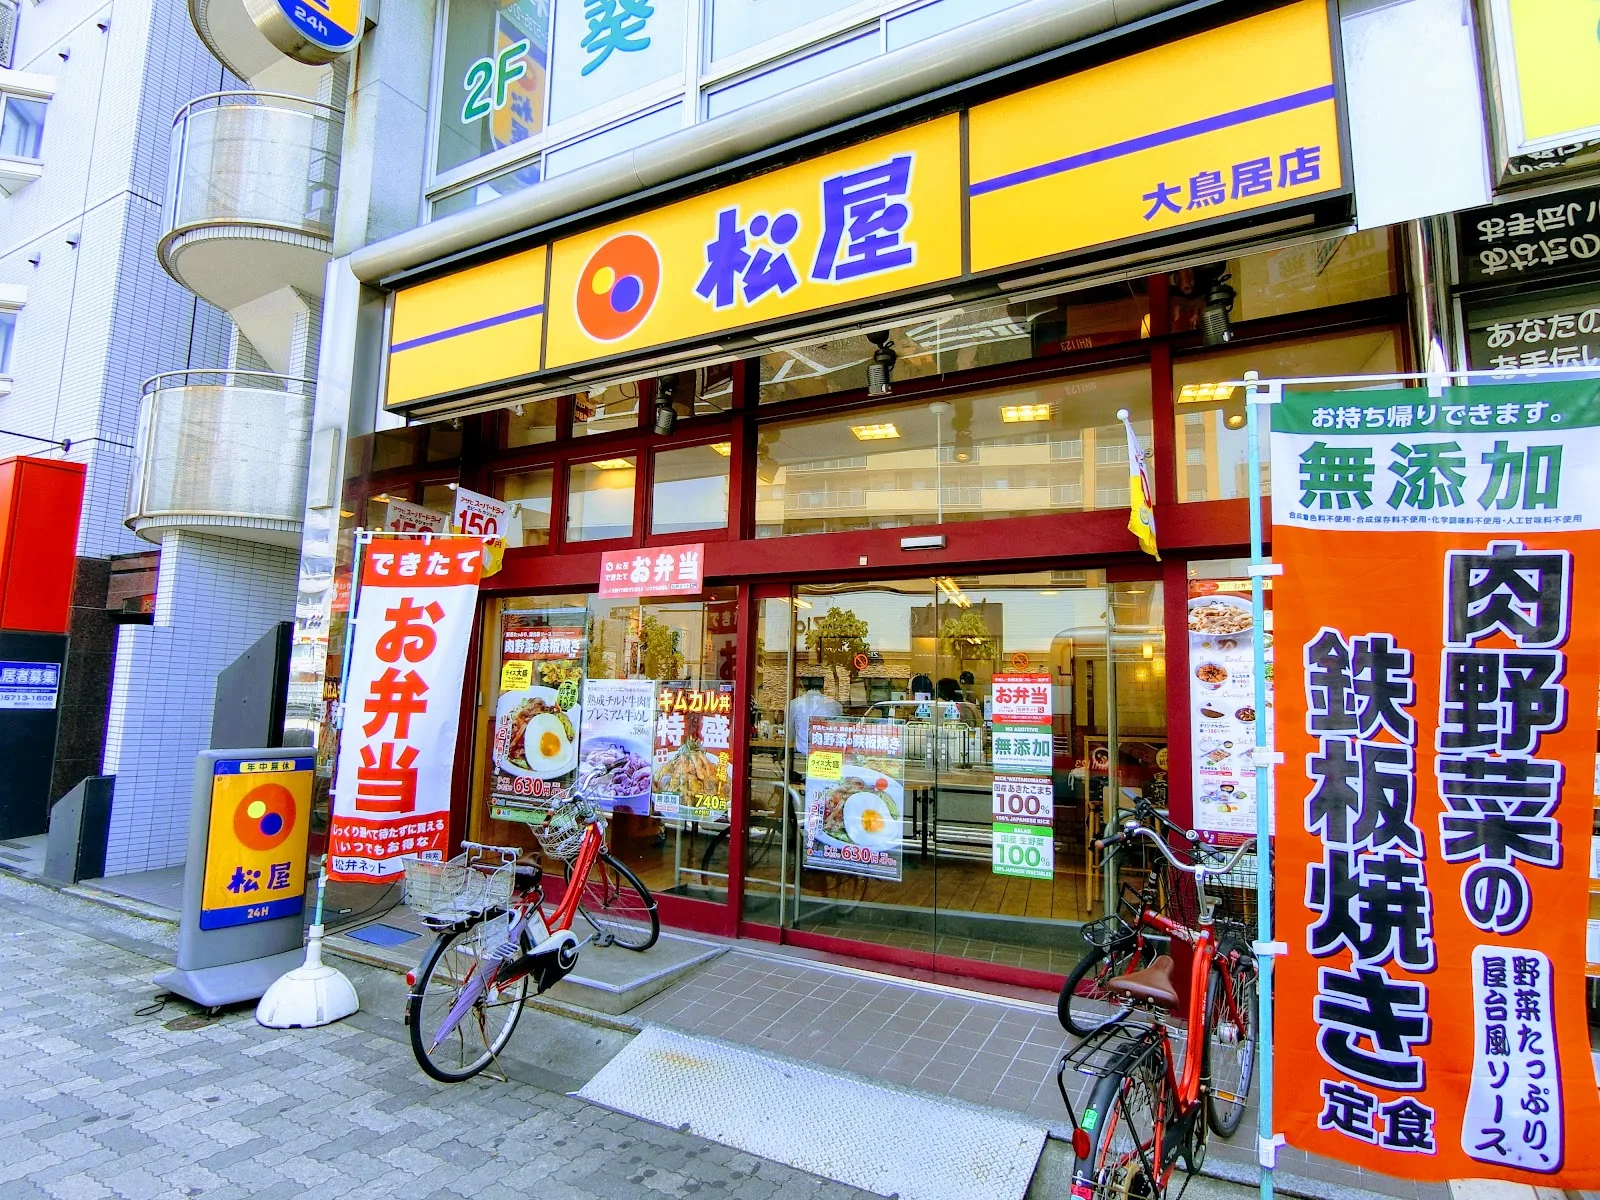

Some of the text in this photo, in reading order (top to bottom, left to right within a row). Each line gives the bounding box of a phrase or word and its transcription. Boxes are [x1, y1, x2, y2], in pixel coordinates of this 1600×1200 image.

[294, 5, 328, 37] 24h
[462, 39, 530, 123] 2F
[1142, 146, 1320, 221] 大鳥居店
[694, 154, 914, 309] 松屋
[1486, 309, 1600, 348] あなたの
[1312, 401, 1563, 430] お持ち帰りできます。
[1298, 441, 1564, 512] 無添加
[372, 550, 481, 577] できたて
[631, 551, 699, 583] お弁当
[605, 573, 628, 582] できたて
[504, 639, 581, 653] 肉野菜の鉄板焼き
[0, 668, 56, 685] 居者募集
[355, 597, 447, 813] お弁当
[659, 688, 731, 712] キムカル丼
[995, 686, 1048, 705] お弁当
[587, 708, 649, 723] プレミアム牛めし
[657, 712, 731, 748] 特盛
[811, 732, 901, 751] 肉野菜の鉄板焼き
[1437, 541, 1571, 933] 肉野菜の
[994, 737, 1050, 757] 無添加
[247, 761, 290, 771] 年中無休
[695, 794, 727, 810] 740円
[994, 783, 1052, 796] 国産あきたこまち
[996, 793, 1050, 815] 100%
[333, 819, 445, 840] じっくり選べて待たずに買える
[340, 836, 430, 856] いつでもお得な
[996, 844, 1050, 867] 100%
[335, 859, 387, 873] 松弁ネット
[1305, 627, 1435, 1091] 鉄板焼き
[227, 862, 292, 894] 松屋
[247, 906, 269, 919] 24H
[1474, 956, 1511, 1157] 屋台風ソース
[1512, 955, 1552, 1163] 野菜たっぷり、
[1321, 1079, 1436, 1154] 定食
